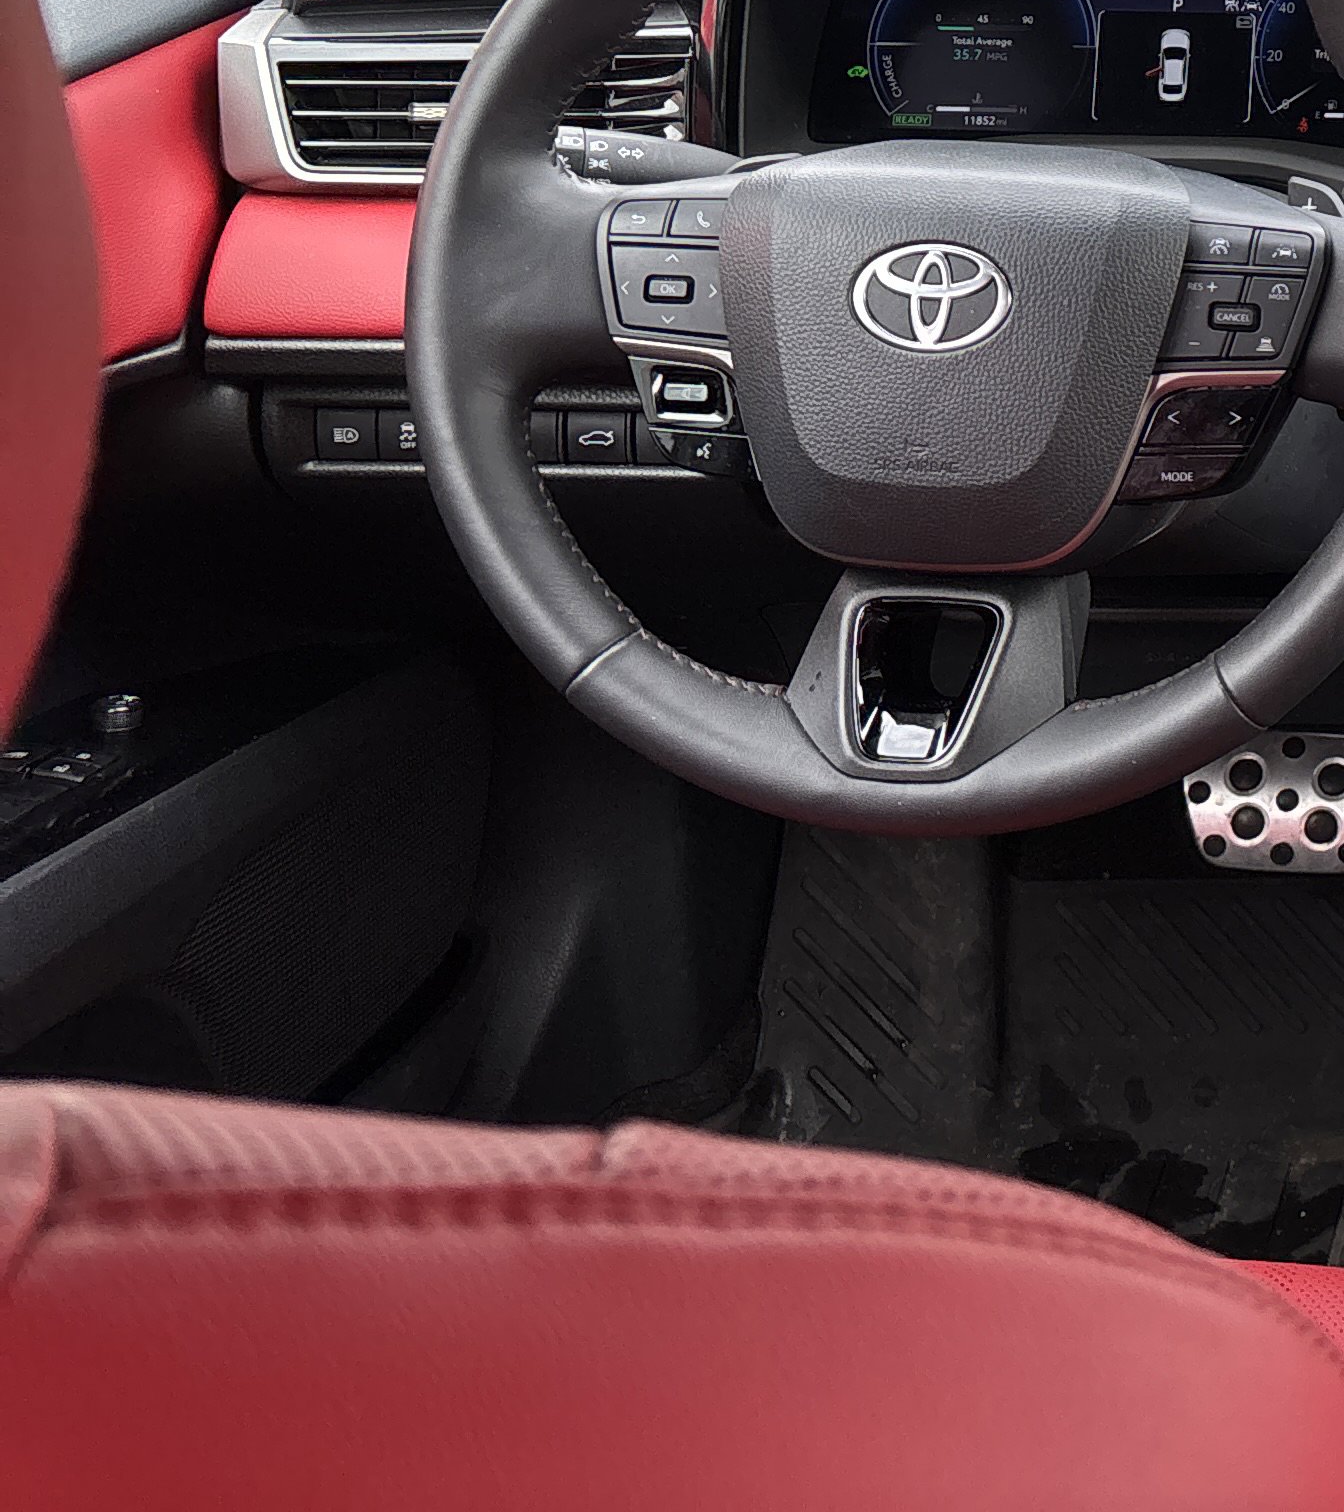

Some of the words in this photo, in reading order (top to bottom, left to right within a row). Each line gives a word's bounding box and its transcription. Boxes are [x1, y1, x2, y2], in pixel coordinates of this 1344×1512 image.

[1278, 2, 1296, 14] 40
[977, 15, 989, 24] 45
[1022, 15, 1034, 24] 90
[952, 36, 974, 45] Total
[975, 37, 1013, 48] Average
[953, 49, 982, 61] 35.7
[1266, 50, 1283, 62] 20
[882, 54, 903, 99] CHARGE
[896, 116, 929, 124] READY
[964, 116, 996, 126] 11852
[660, 284, 676, 294] OK
[1216, 312, 1250, 322] CANCEL
[1161, 471, 1194, 483] MODE
